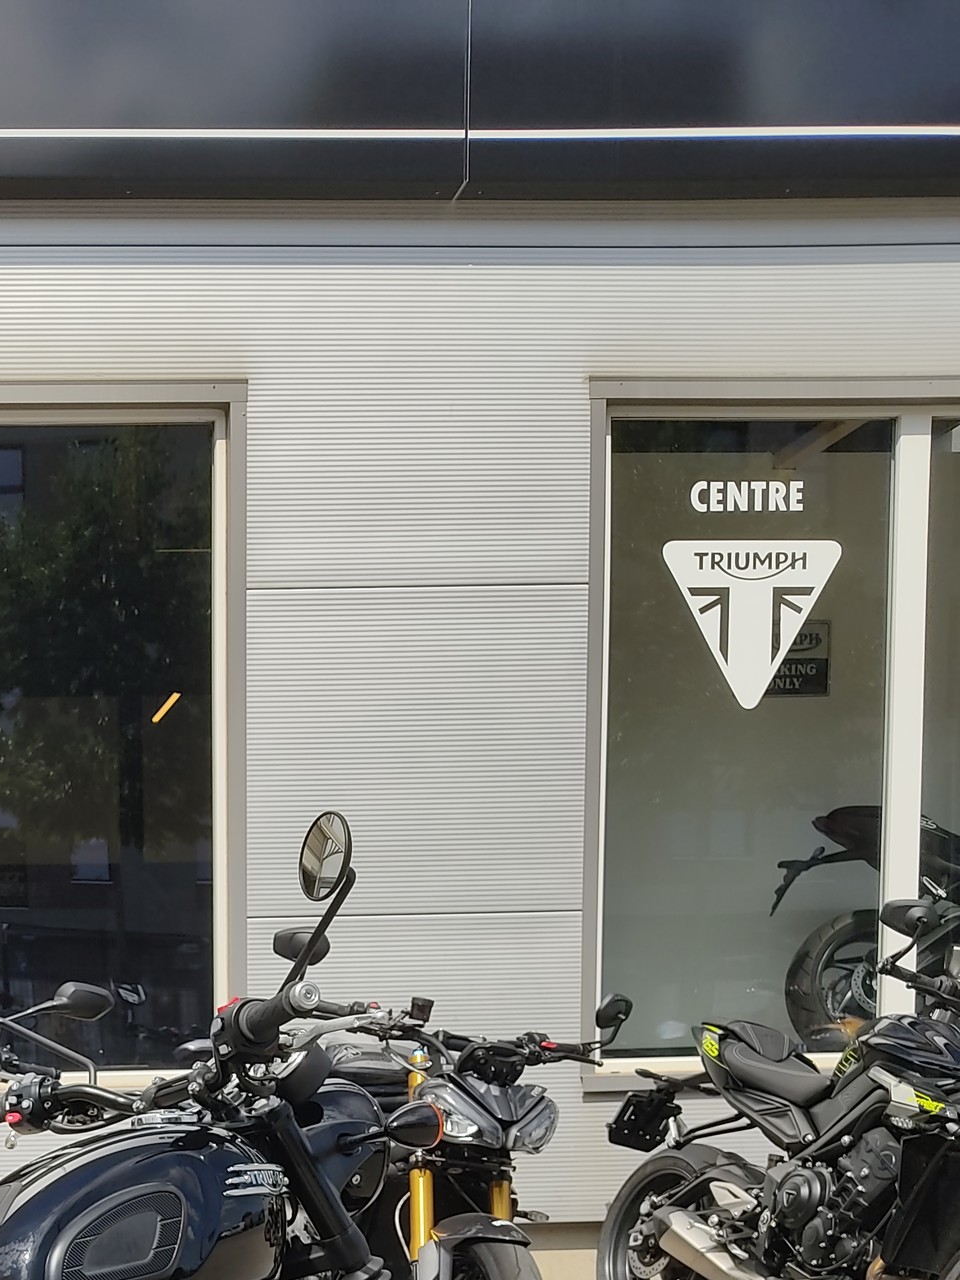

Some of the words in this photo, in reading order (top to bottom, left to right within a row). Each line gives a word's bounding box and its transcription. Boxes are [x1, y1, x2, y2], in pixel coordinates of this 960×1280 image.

[690, 480, 804, 513] CENTRE
[694, 552, 807, 573] TRIUMPH
[776, 664, 816, 675] KING
